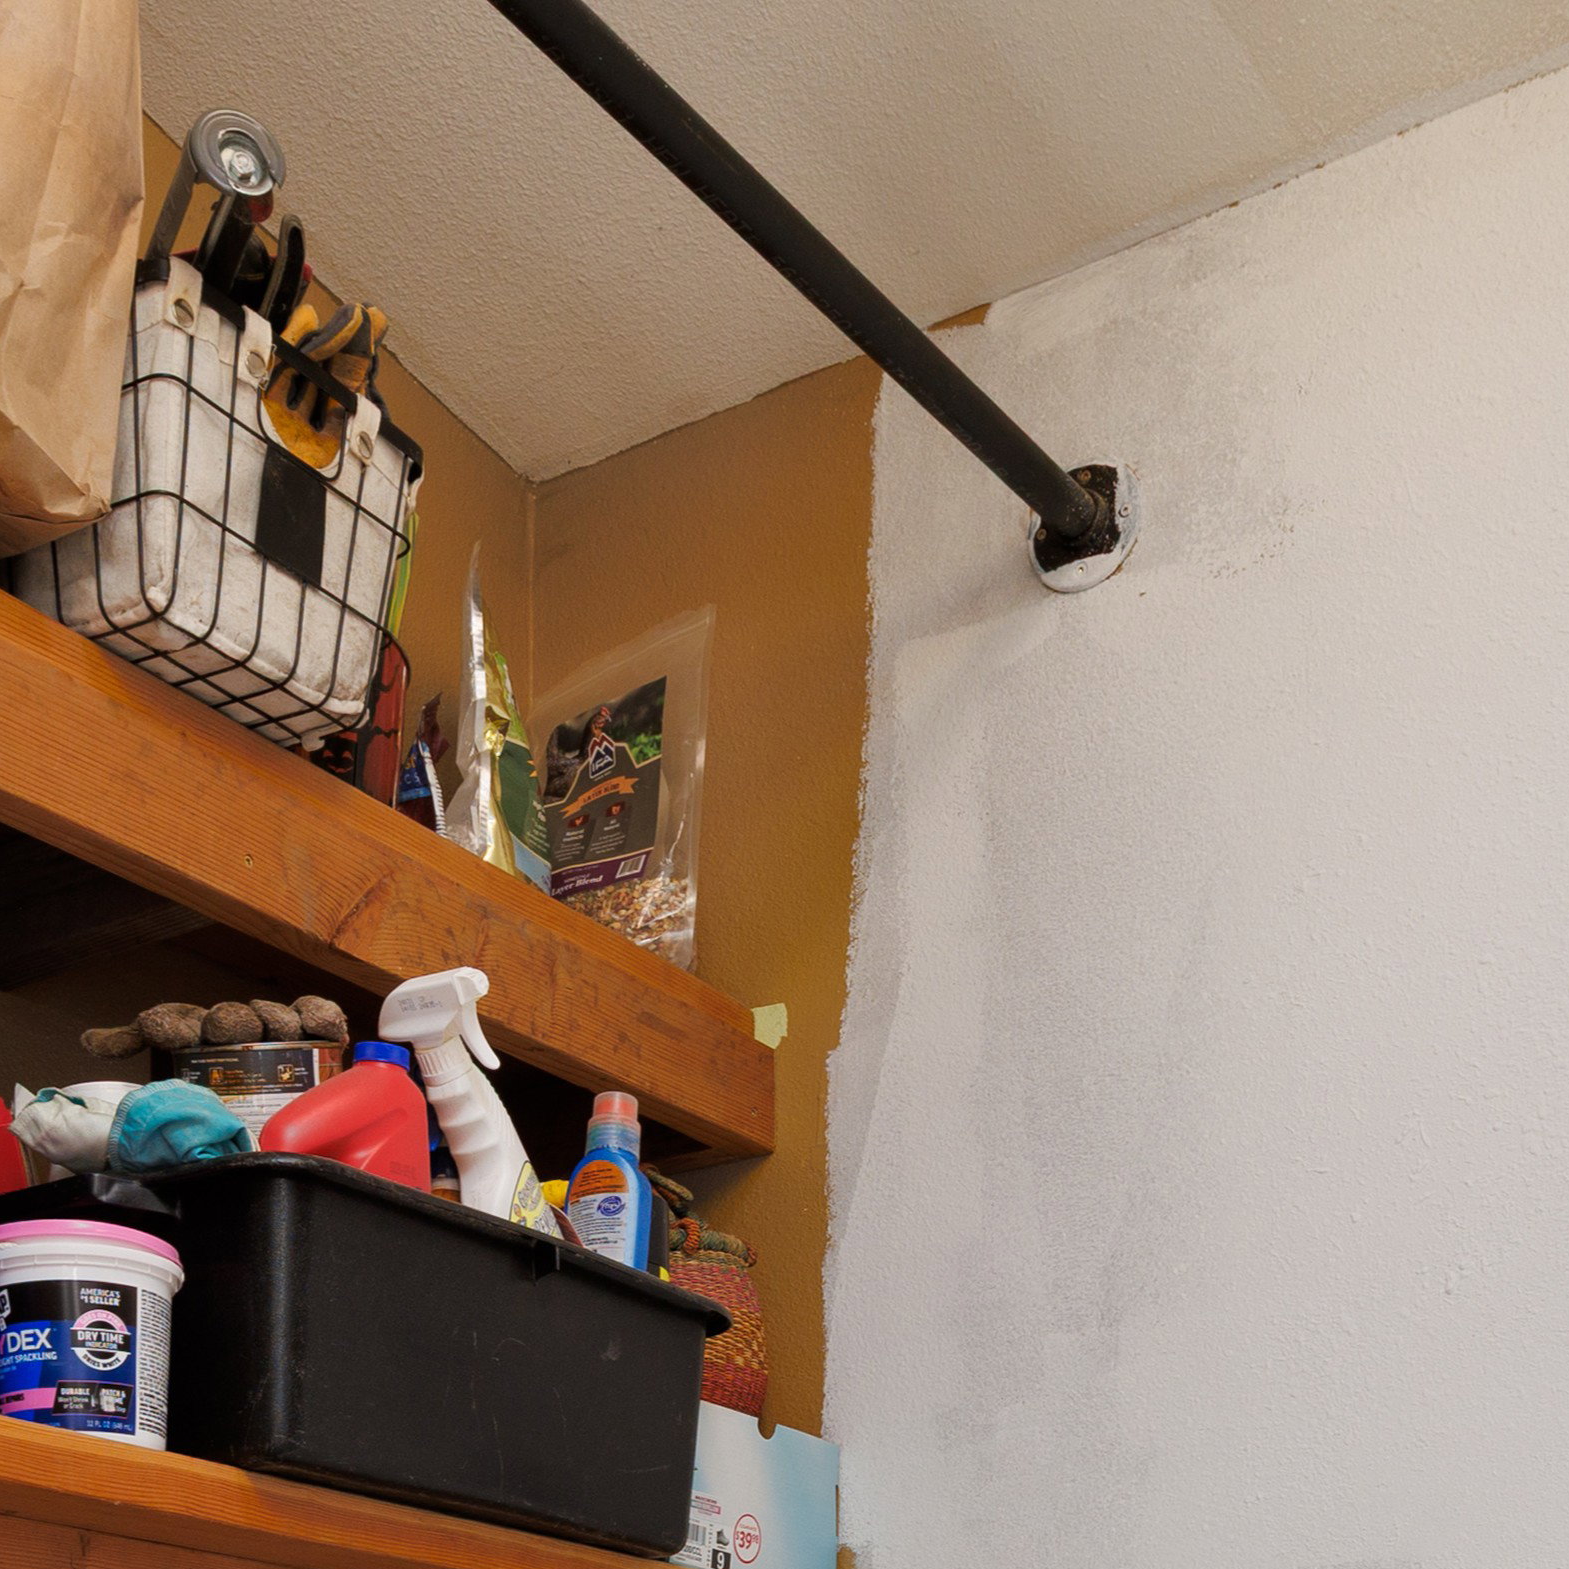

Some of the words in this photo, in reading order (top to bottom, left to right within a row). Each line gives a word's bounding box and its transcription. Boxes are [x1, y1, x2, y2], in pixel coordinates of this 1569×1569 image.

[80, 1287, 121, 1298] AMERICA'S
[89, 1296, 120, 1307] SELLER
[77, 1331, 99, 1342] DRY
[100, 1332, 125, 1345] TIME
[14, 1351, 58, 1364] SPACKLING
[716, 1552, 726, 1569] 9
